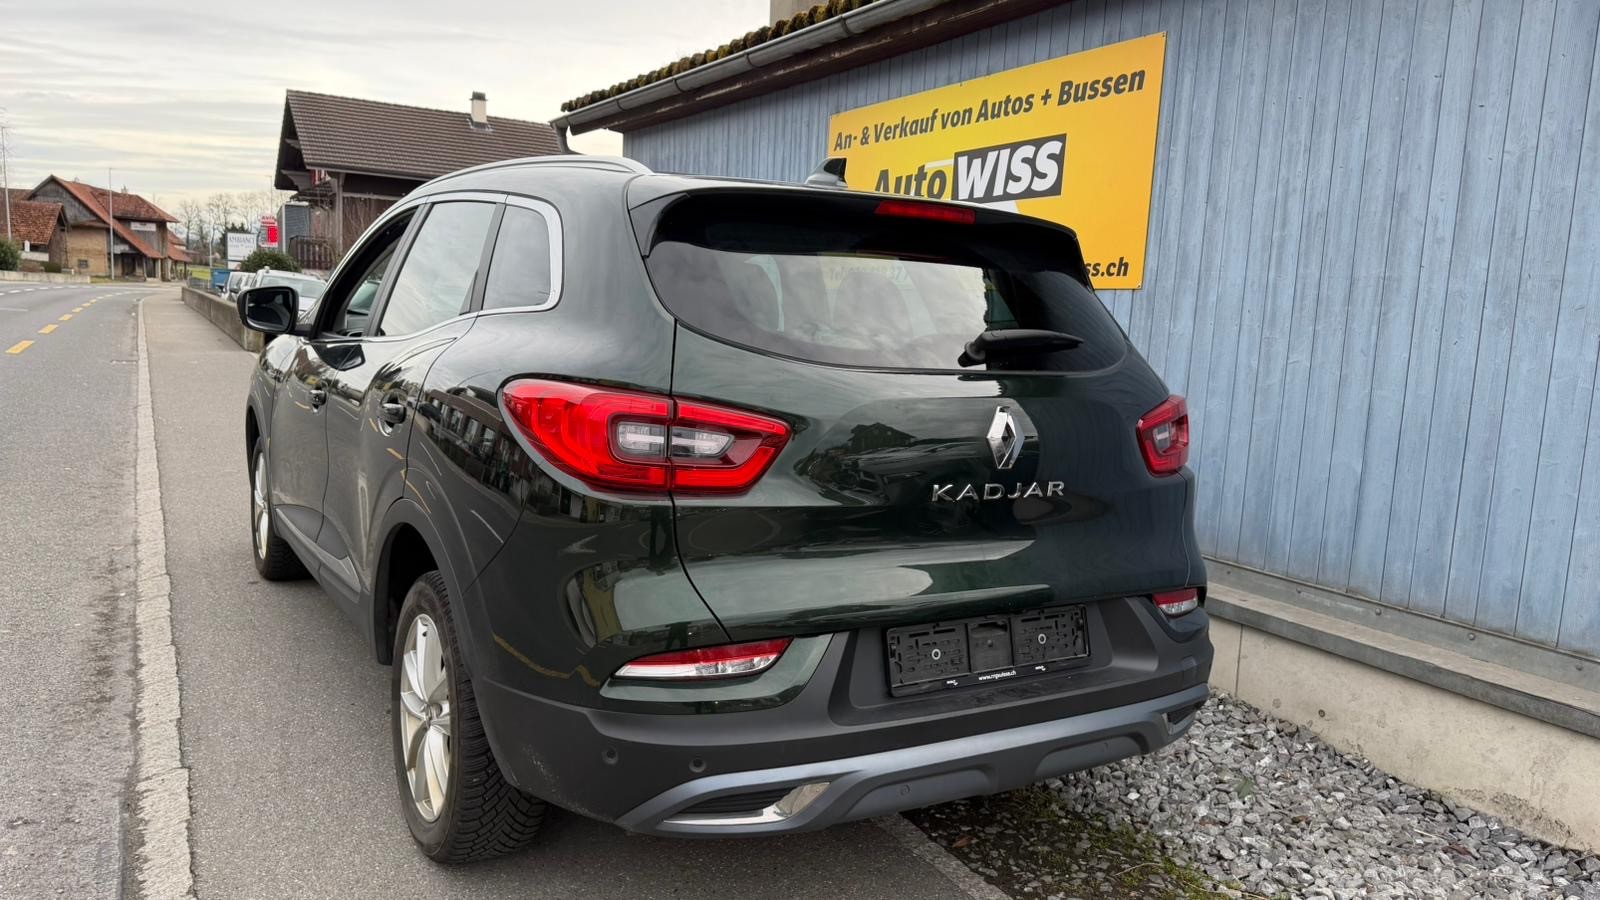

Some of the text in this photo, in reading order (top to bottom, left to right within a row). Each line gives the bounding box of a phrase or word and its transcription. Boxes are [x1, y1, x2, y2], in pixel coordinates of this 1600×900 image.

[834, 69, 1146, 151] An- & Verkauf von Autos + Bussen
[874, 140, 1064, 201] Auto WISS
[931, 481, 1066, 502] KADJAR
